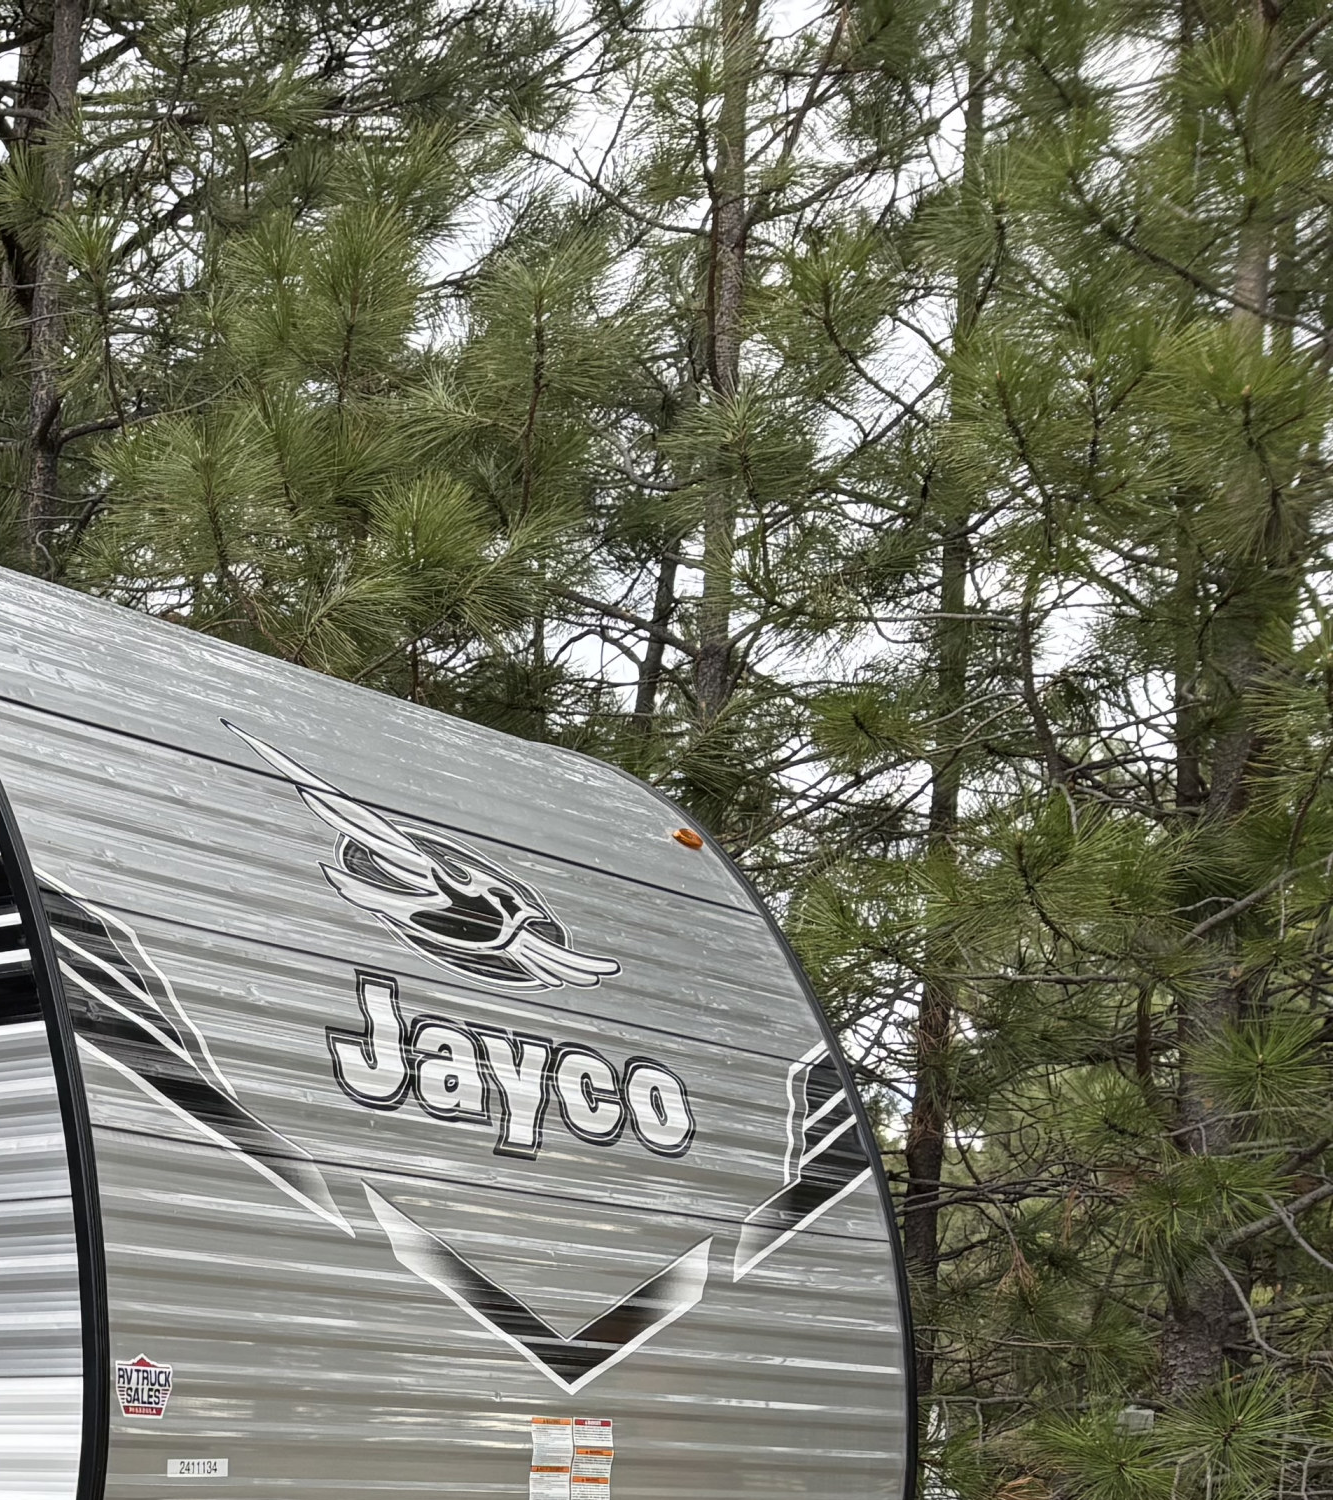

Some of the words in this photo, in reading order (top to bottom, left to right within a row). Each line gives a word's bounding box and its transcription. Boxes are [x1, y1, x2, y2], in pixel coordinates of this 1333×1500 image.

[325, 968, 697, 1162] Jayco
[117, 1367, 133, 1386] RV
[134, 1368, 171, 1388] TRUCK
[125, 1387, 161, 1405] SALES
[179, 1460, 218, 1475] 2411134
